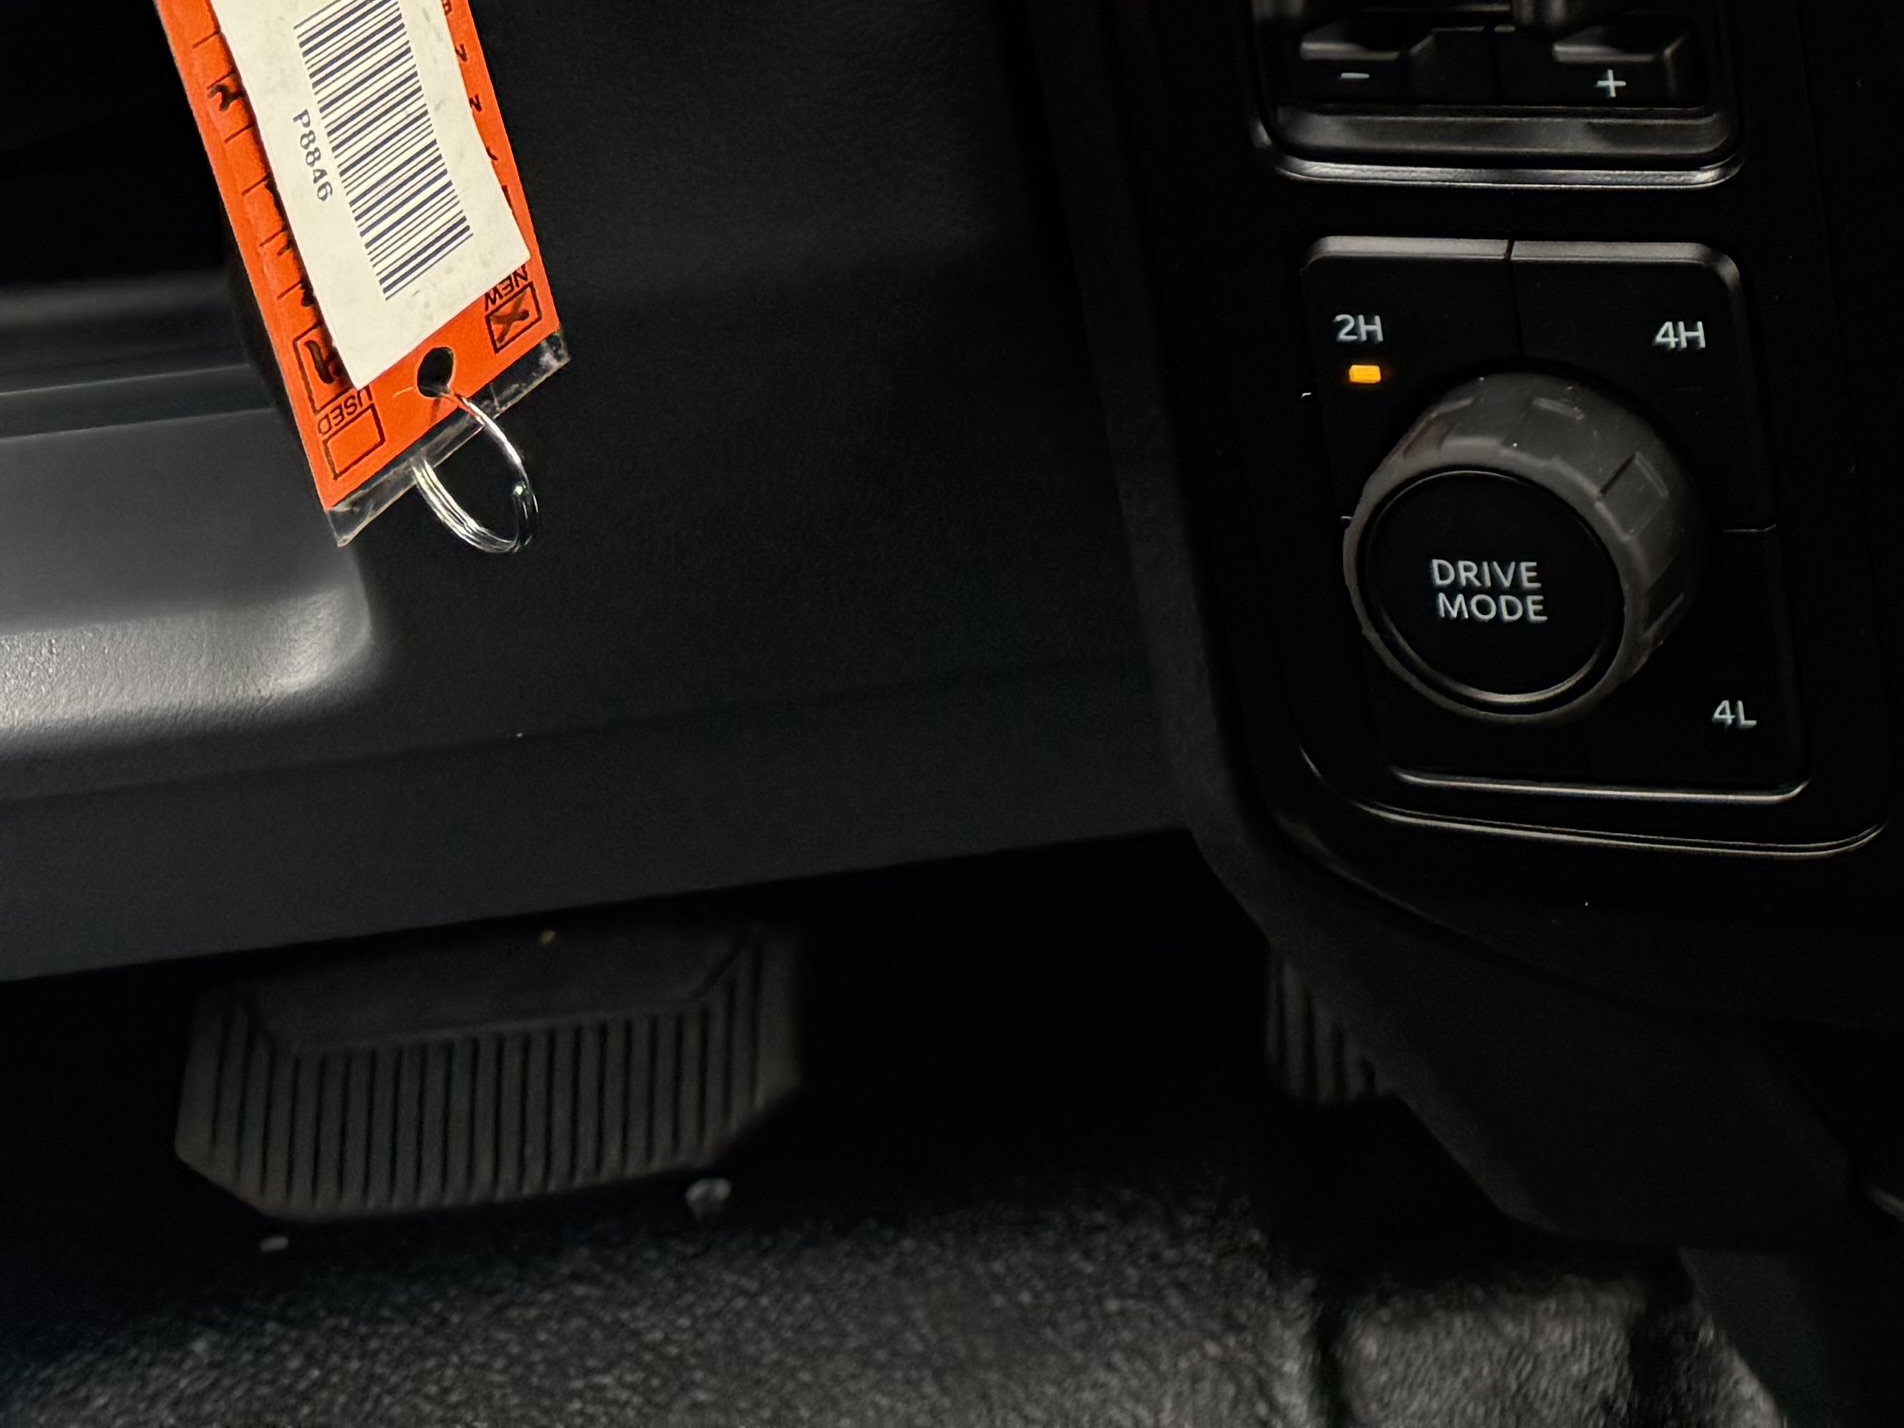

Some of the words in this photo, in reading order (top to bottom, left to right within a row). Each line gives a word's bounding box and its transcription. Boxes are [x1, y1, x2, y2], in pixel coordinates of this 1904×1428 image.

[292, 107, 334, 203] P8846
[1334, 313, 1384, 342] 2H
[1654, 320, 1706, 349] 4H
[1431, 558, 1541, 590] DRIVE
[1437, 592, 1548, 623] MODE
[1712, 699, 1757, 727] 4L
